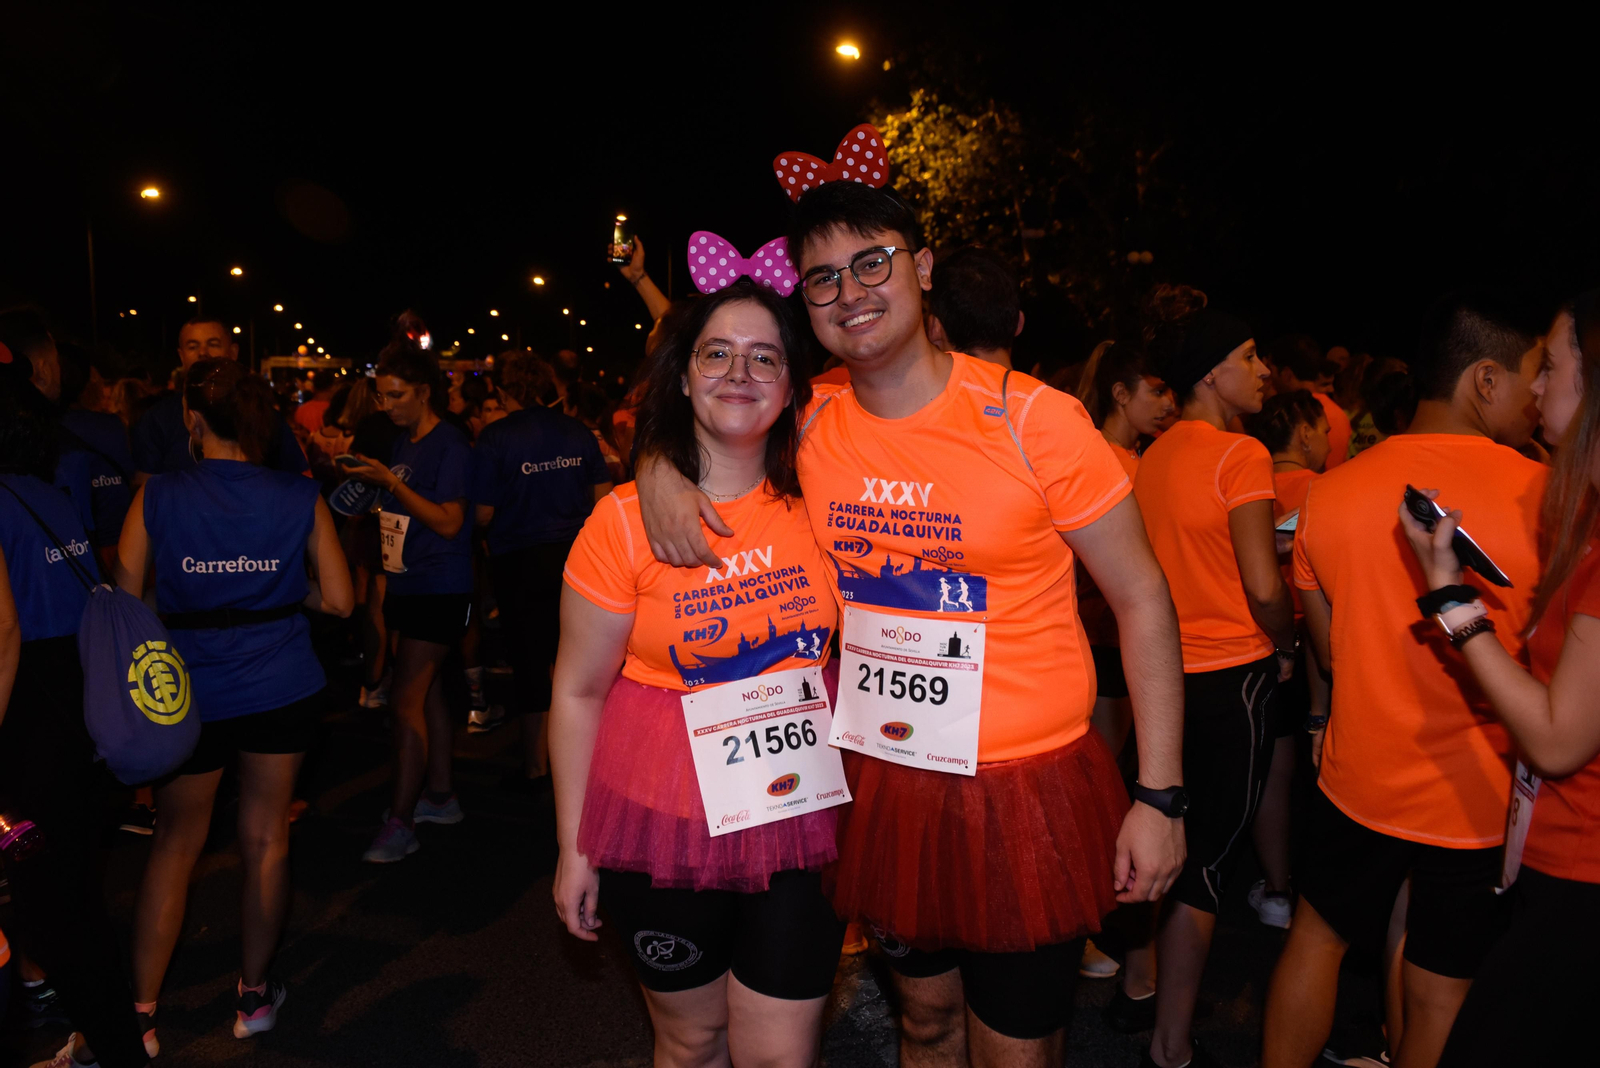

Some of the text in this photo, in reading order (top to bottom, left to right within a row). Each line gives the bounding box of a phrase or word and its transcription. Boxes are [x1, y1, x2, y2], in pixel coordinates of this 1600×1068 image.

[521, 456, 582, 474] Carrefour
[339, 482, 366, 506] life
[860, 477, 934, 507] XXXV
[829, 502, 962, 524] CARRERA NOCTURNA
[835, 516, 962, 541] GUADALQUIVIR
[181, 556, 280, 574] Carrefour
[706, 545, 772, 584] XXXV
[673, 564, 805, 602] CARRERA NOCTURNA
[840, 590, 854, 599] 023
[684, 576, 810, 616] GUADALQUIVIR
[873, 652, 897, 661] NOCTURNA
[908, 658, 948, 667] GUADALQUIVIR
[858, 663, 948, 705] 21569
[713, 722, 737, 730] CARRERA
[738, 714, 766, 725] NOCTURNA
[776, 706, 807, 715] GUADALQUIVIR
[722, 719, 816, 766] 21566
[927, 753, 968, 765] Cruzcampo
[816, 789, 844, 800] Cruzcampo
